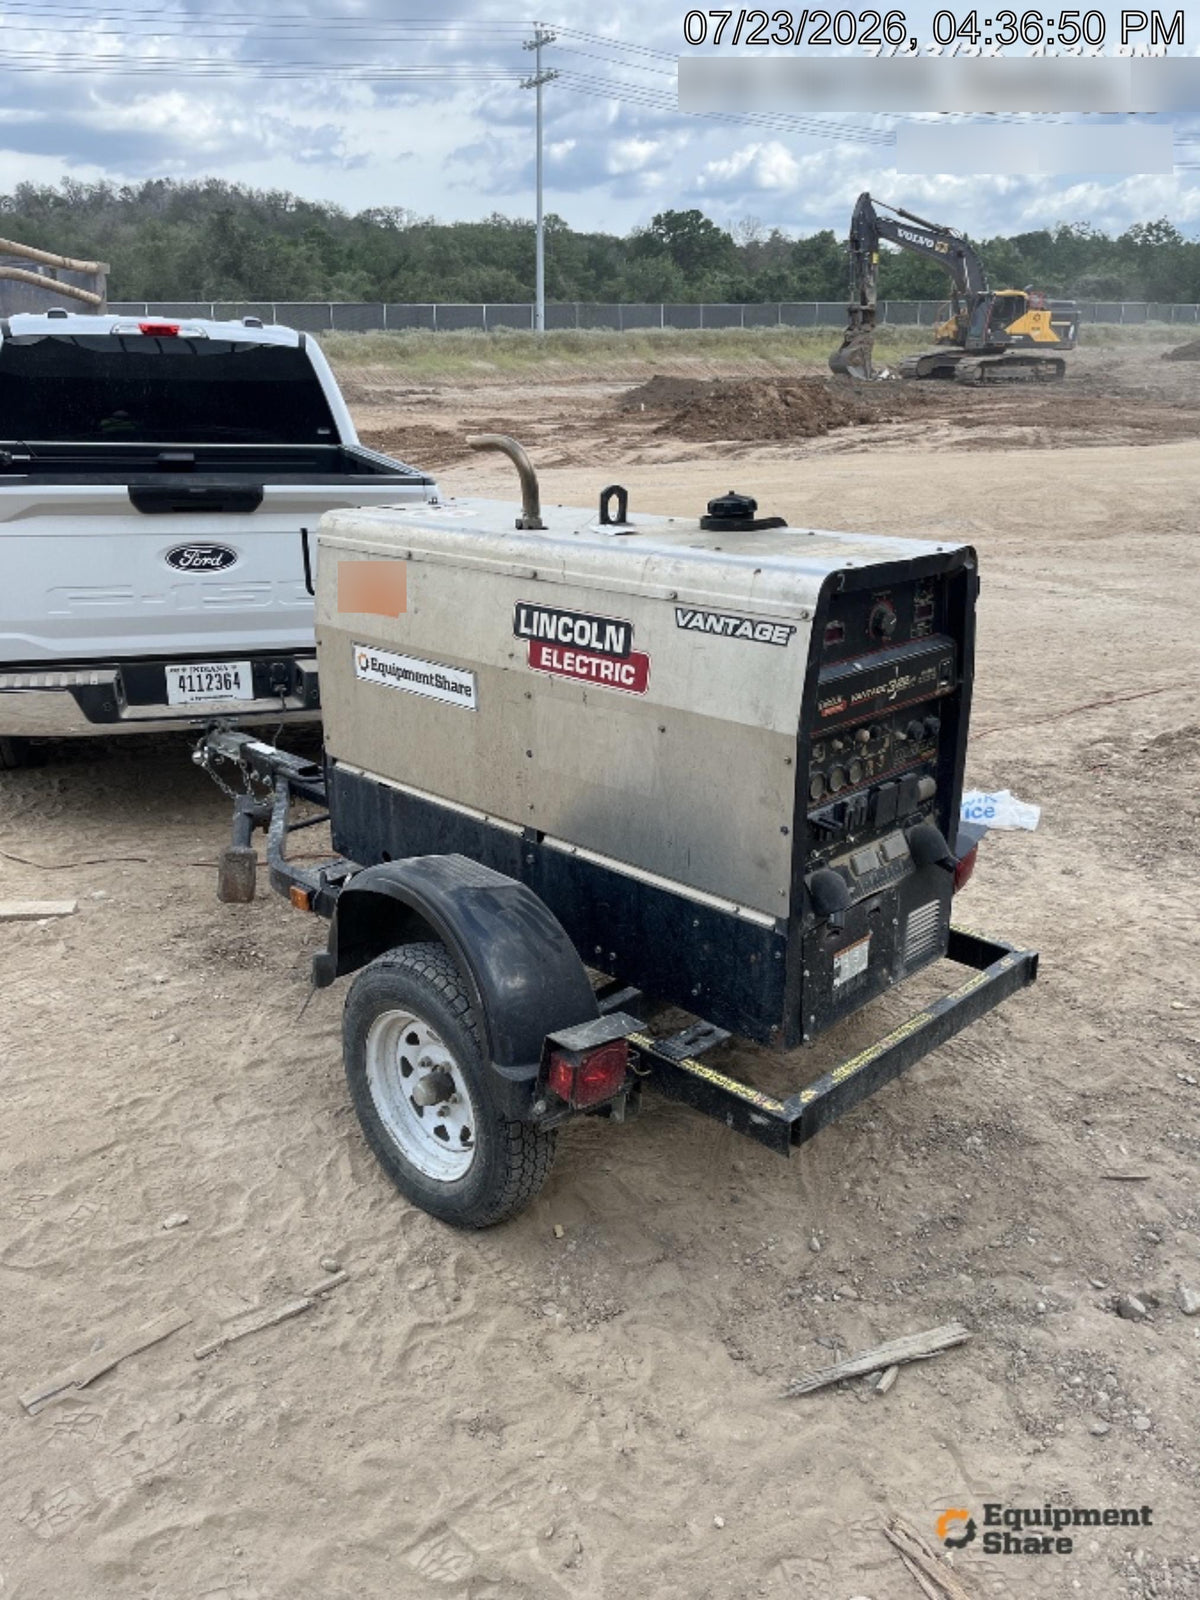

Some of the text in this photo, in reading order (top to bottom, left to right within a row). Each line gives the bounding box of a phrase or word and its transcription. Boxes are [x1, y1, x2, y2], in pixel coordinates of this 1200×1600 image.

[897, 228, 934, 248] VOLVO
[178, 549, 223, 567] Ford
[519, 609, 625, 653] LINCOLN
[676, 607, 791, 646] VANTAGE
[179, 671, 241, 693] 4112364
[370, 657, 472, 697] EquipmentShare
[540, 647, 636, 686] ELECTRIC
